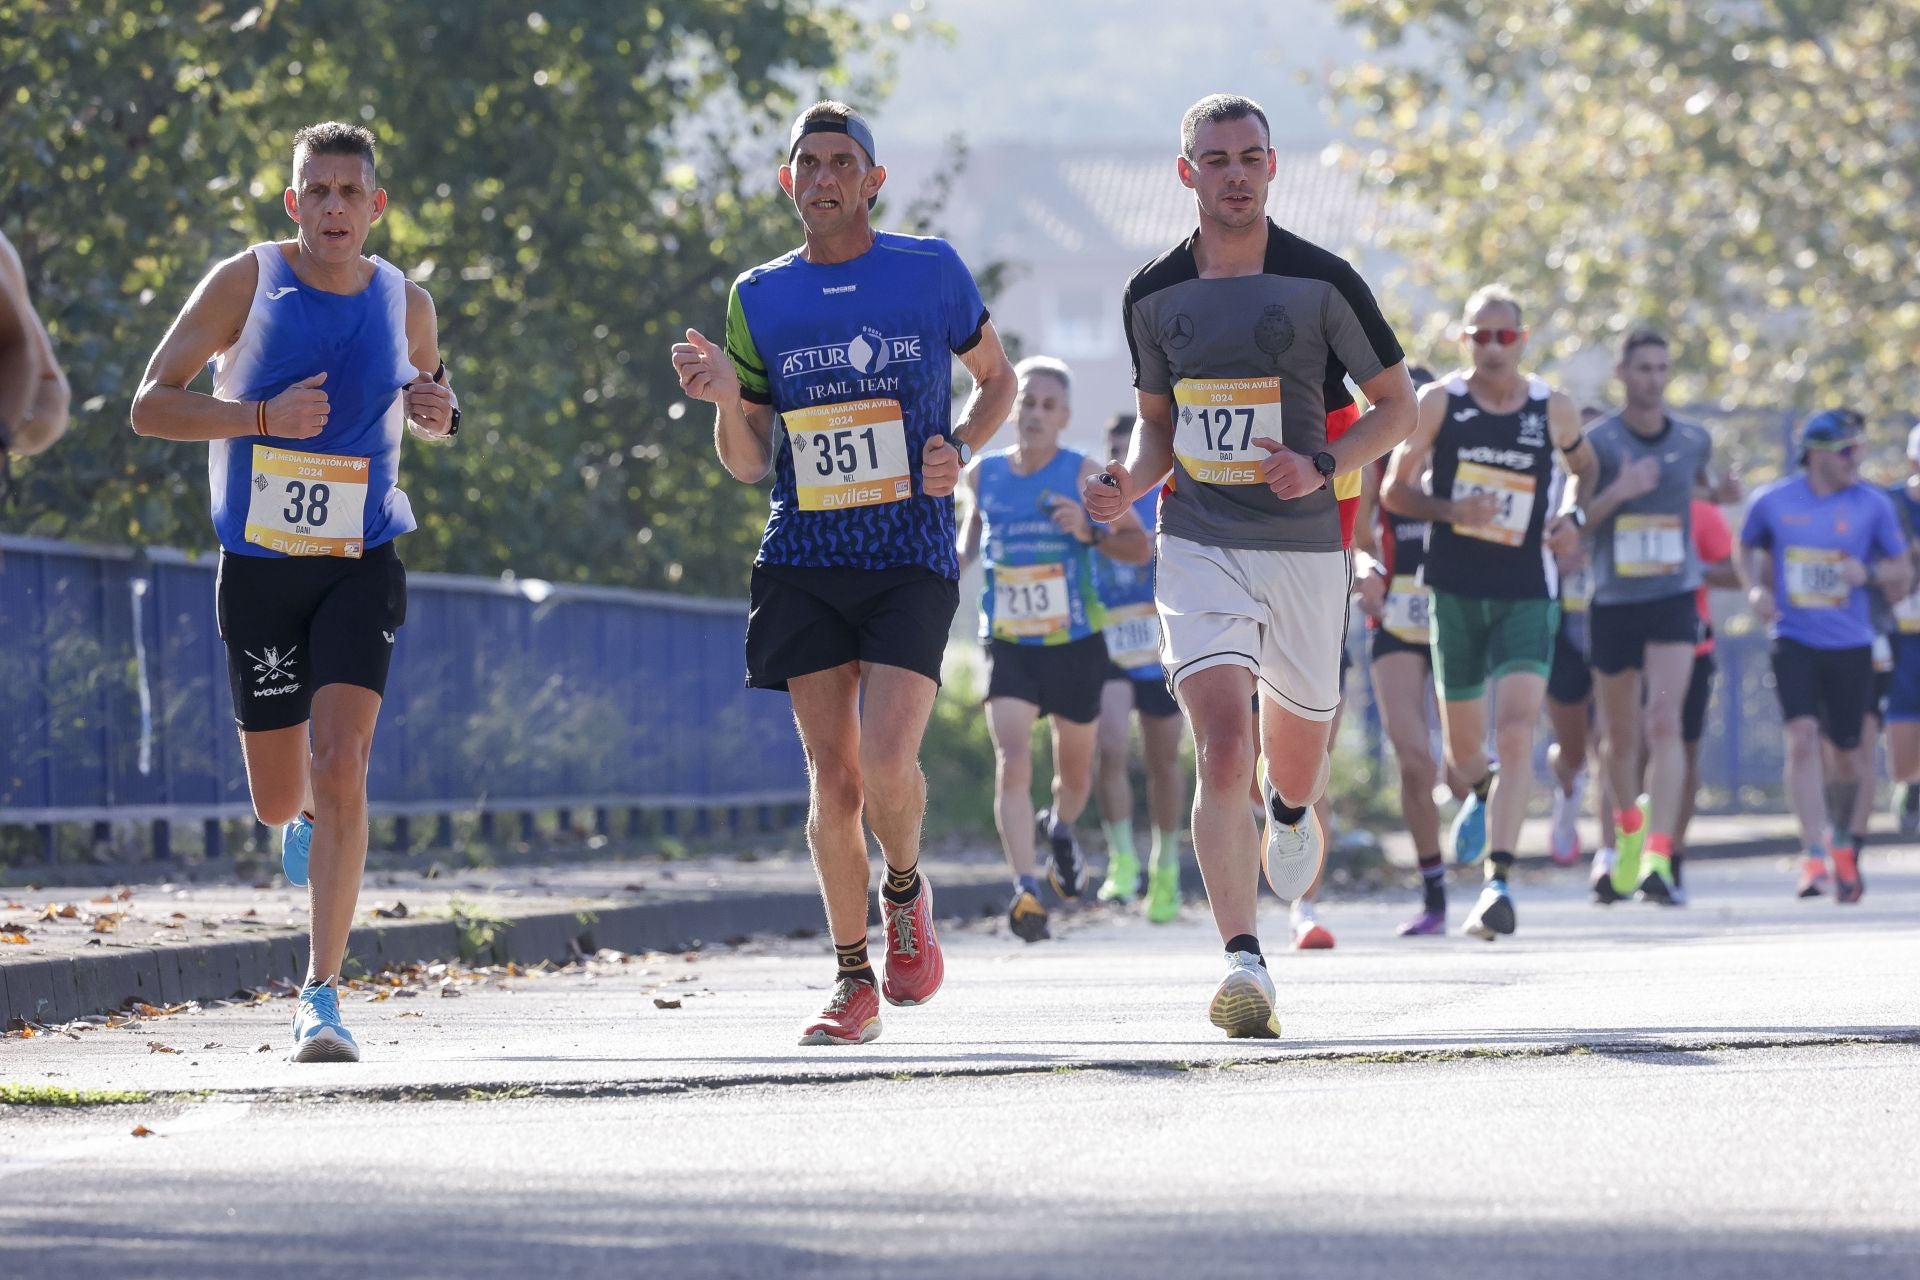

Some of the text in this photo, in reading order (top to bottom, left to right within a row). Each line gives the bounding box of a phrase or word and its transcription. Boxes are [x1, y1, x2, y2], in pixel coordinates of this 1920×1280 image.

[782, 339, 922, 374] ASTUR PIE
[806, 377, 899, 400] TRAIL TEAM
[1213, 381, 1250, 391] MARATÓN
[1251, 379, 1278, 390] AVILÉS
[1210, 393, 1233, 402] 2024
[831, 402, 870, 414] MARATÓN
[871, 399, 898, 408] AVILÉS
[828, 415, 854, 427] 2024
[1198, 407, 1255, 451] 127
[813, 427, 879, 477] 351
[1457, 446, 1537, 470] WOLVES
[279, 453, 300, 462] MEDIA
[303, 457, 342, 467] MARATÓN
[343, 459, 367, 469] AVS
[297, 466, 324, 478] 2024
[843, 474, 856, 483] NEL
[1196, 467, 1256, 482] avilés
[283, 480, 330, 526] 38
[822, 487, 883, 506] avilés
[295, 525, 311, 535] DANI
[271, 538, 333, 555] avilés
[1007, 583, 1050, 615] 213
[253, 682, 302, 698] WOLVES
